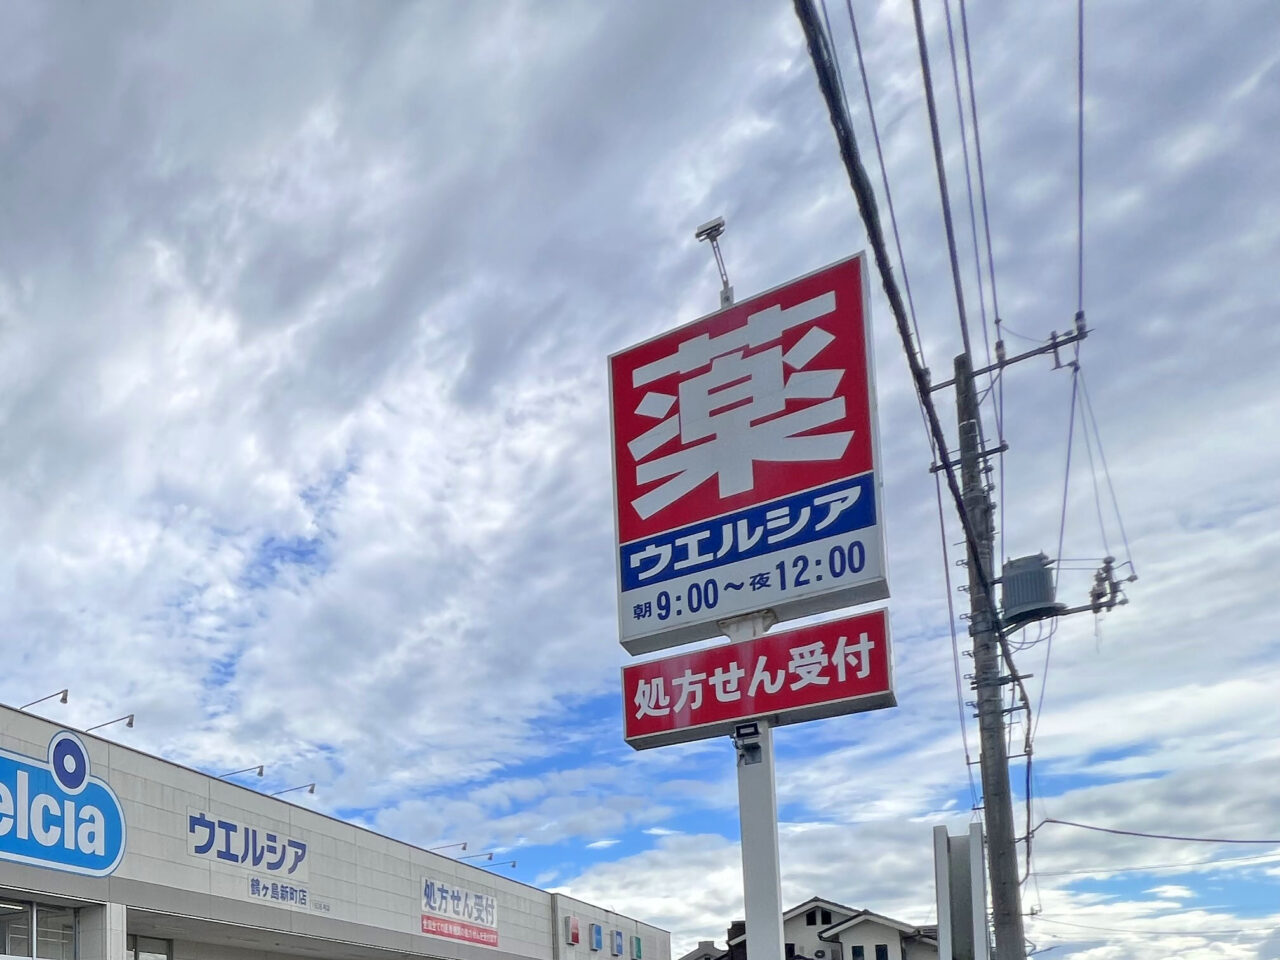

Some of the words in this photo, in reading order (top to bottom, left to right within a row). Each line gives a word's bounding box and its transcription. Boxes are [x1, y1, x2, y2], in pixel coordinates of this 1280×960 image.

[627, 290, 855, 521] 薬
[629, 486, 861, 581] ウエルシア
[633, 632, 875, 720] 処方せん受付
[189, 813, 307, 874] ウエルシア
[424, 879, 495, 926] 処方せん受付
